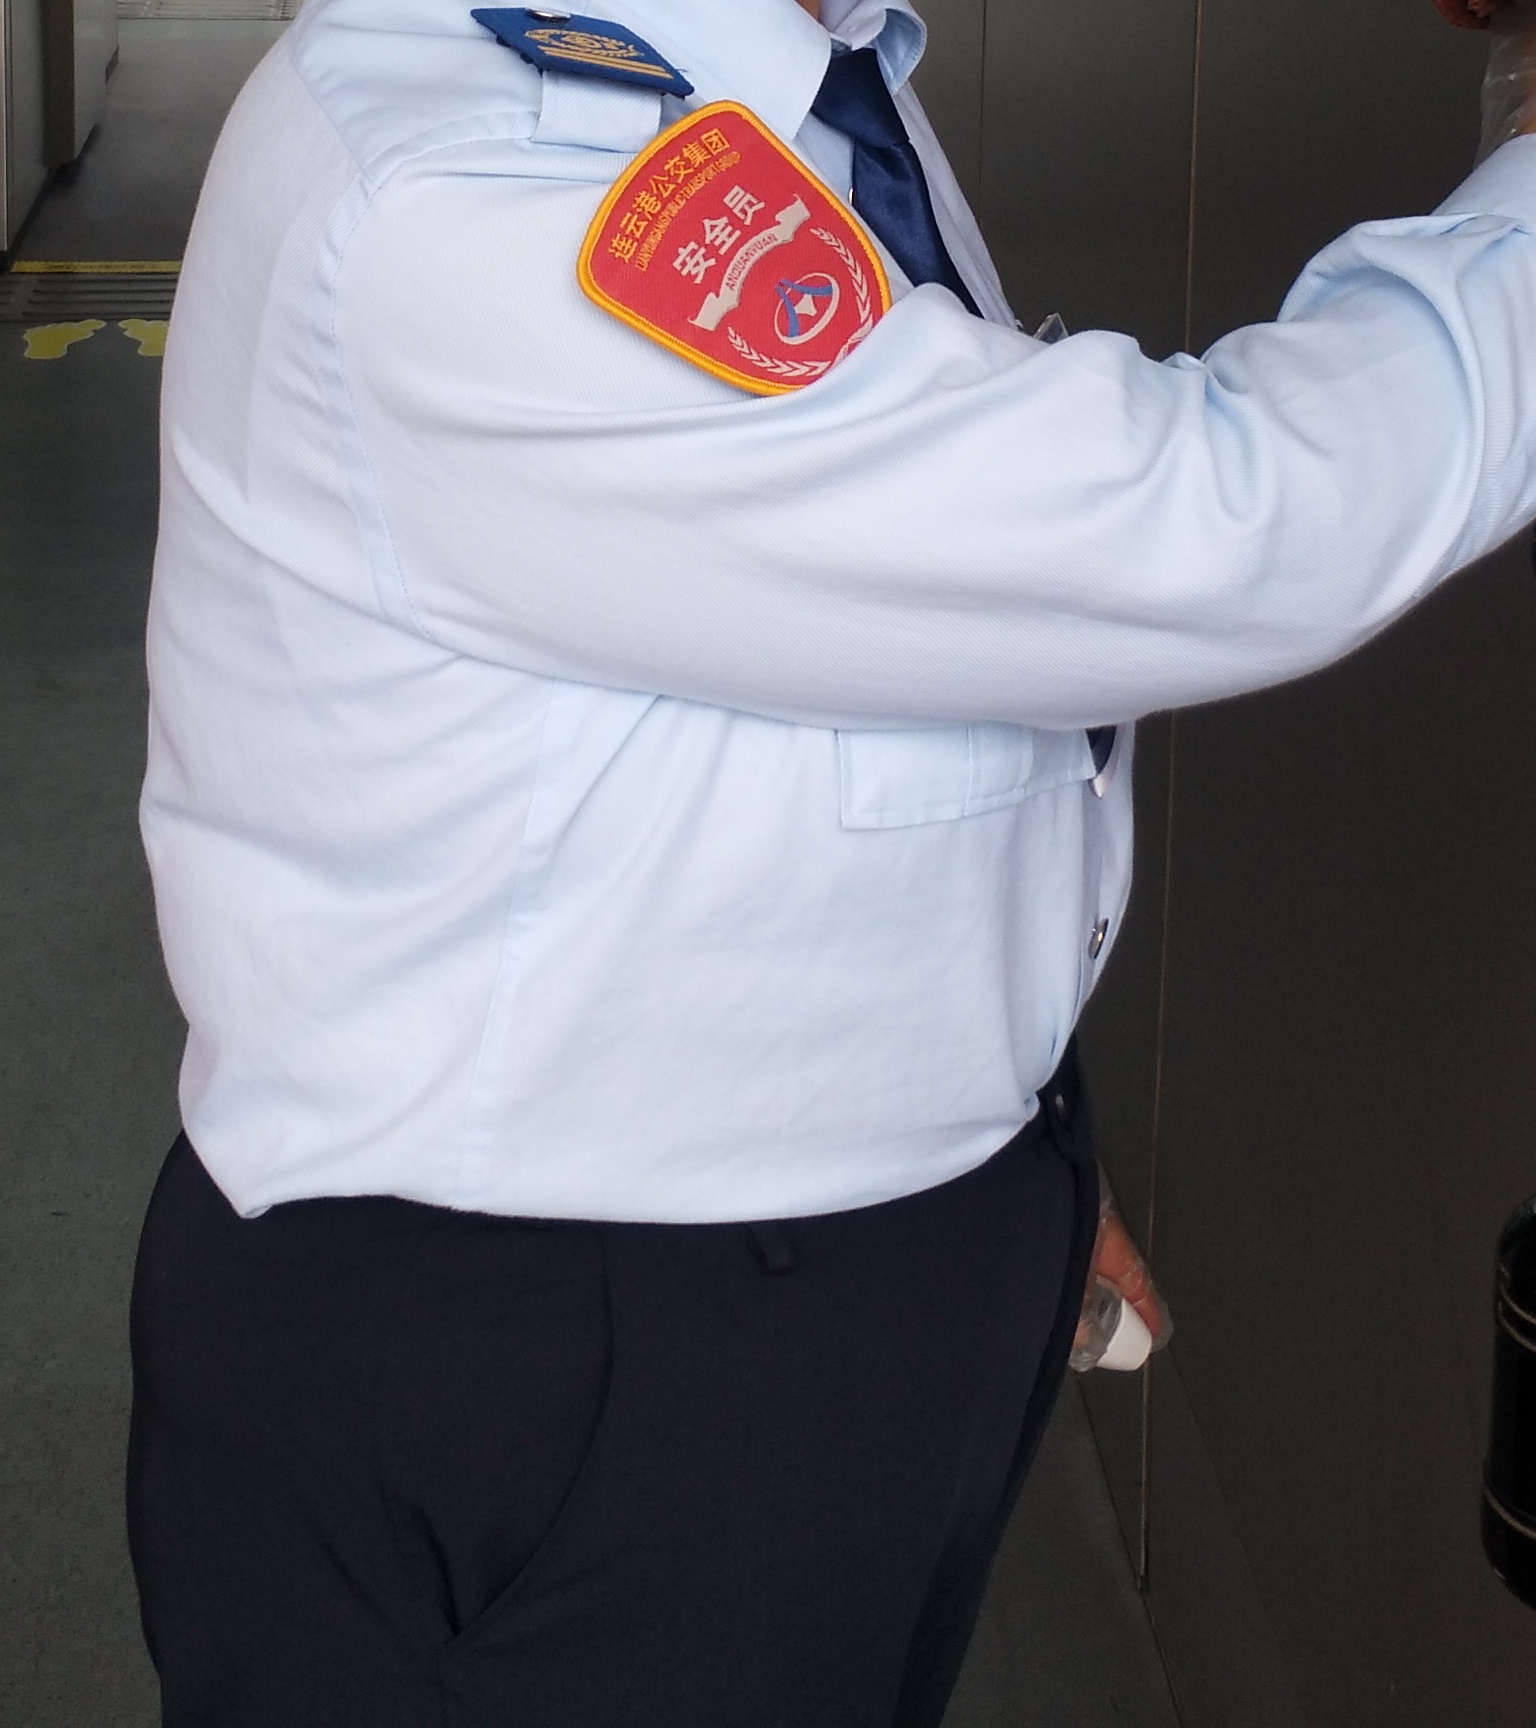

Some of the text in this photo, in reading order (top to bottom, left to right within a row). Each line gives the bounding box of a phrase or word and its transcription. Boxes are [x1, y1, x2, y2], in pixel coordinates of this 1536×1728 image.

[608, 128, 731, 264] 连云港公交集团
[672, 184, 765, 284] 安全员
[725, 233, 778, 291] ANQUANYUAN
